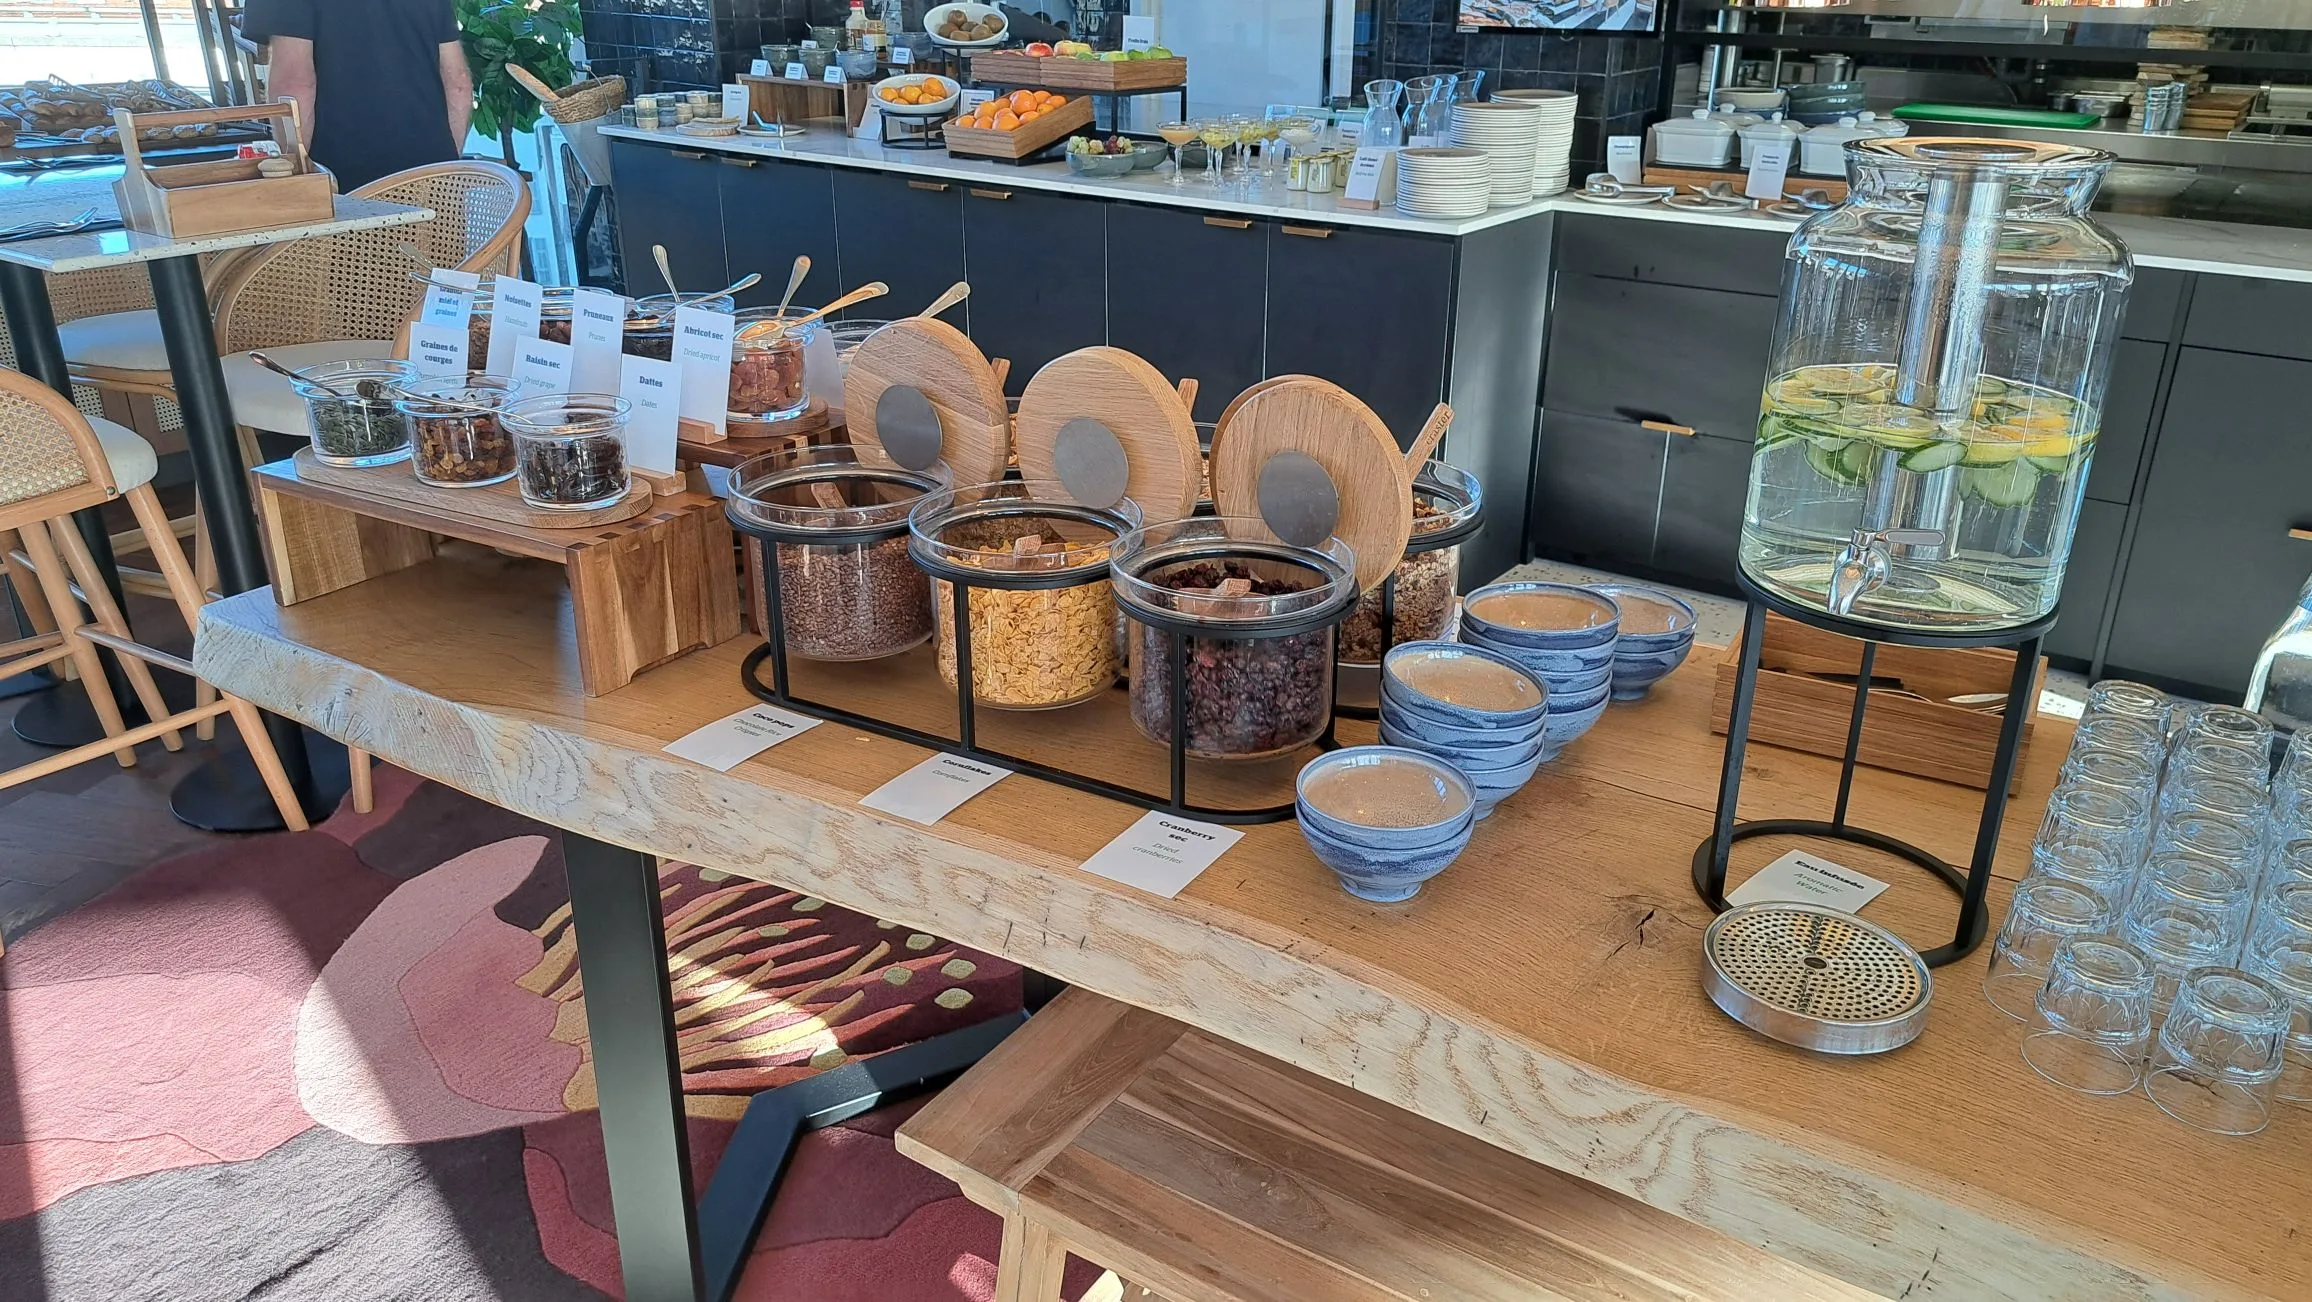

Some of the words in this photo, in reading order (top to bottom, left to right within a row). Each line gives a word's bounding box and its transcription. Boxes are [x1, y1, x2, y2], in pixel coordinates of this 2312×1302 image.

[505, 294, 532, 308] Noisettes
[583, 308, 614, 322] Pruneaux
[588, 331, 606, 342] Prunes
[684, 325, 711, 338] Abricot
[712, 332, 724, 341] sec
[420, 340, 449, 352] Graines
[449, 344, 458, 353] de
[424, 354, 453, 365] courges
[526, 354, 548, 367] Raisin
[548, 360, 560, 369] sec
[683, 347, 699, 358] Dried
[699, 351, 721, 363] apricot
[639, 375, 663, 388] Dattes
[641, 399, 657, 409] Dates
[753, 712, 773, 722] Coco
[771, 719, 795, 729] pops
[942, 759, 992, 776] Cornflakes
[932, 769, 971, 783] Cornflakes
[1159, 820, 1216, 841] Cranberry
[1168, 832, 1188, 843] sec
[1131, 846, 1184, 864] cranberries
[1152, 842, 1180, 854] Dried
[1795, 860, 1818, 872] Eau
[1793, 873, 1843, 893] Aromatic
[1796, 880, 1828, 895] Water
